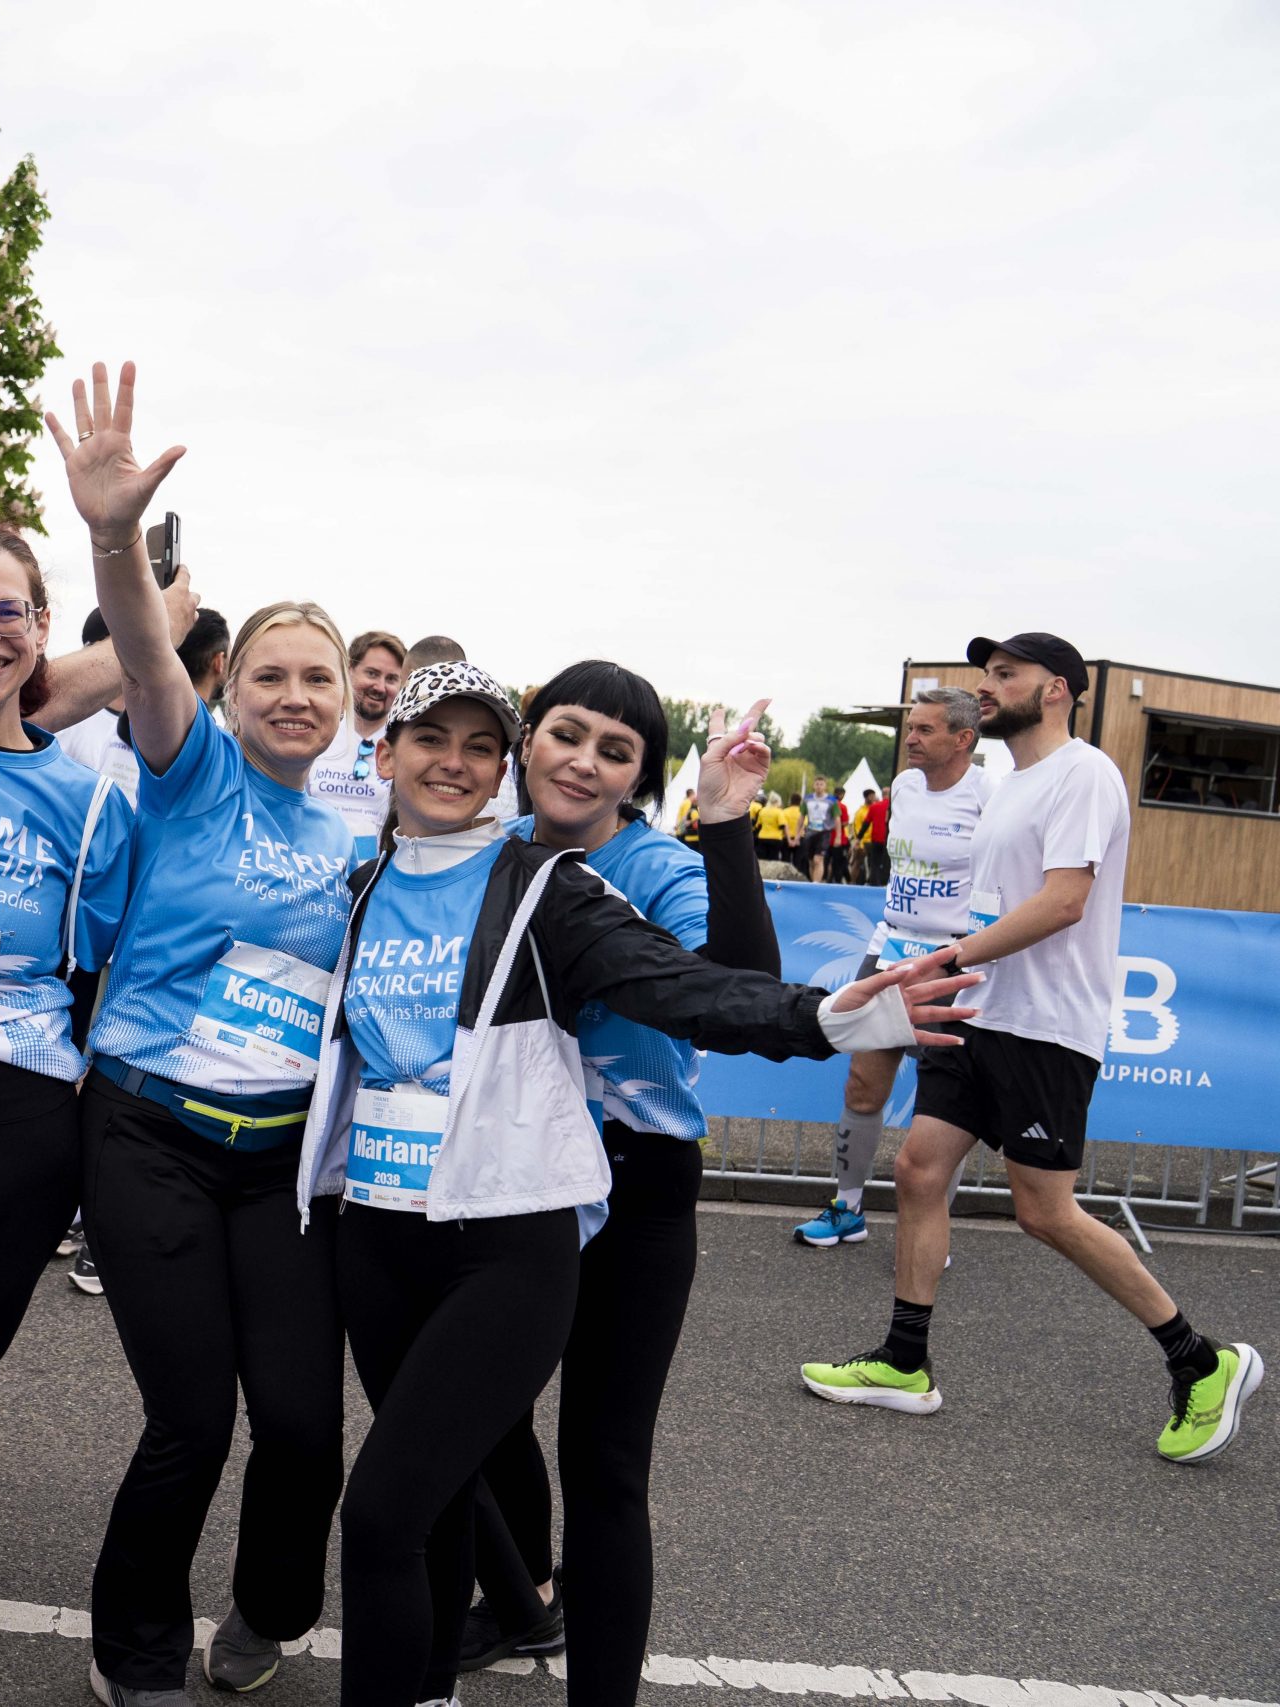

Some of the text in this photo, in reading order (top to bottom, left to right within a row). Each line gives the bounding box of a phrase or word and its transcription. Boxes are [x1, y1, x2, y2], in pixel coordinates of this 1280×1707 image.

[319, 781, 376, 797] Controls
[235, 872, 277, 900] Folge
[305, 901, 324, 916] ins
[222, 974, 321, 1036] Karolina
[390, 1004, 411, 1020] ins
[256, 1023, 285, 1042] 2057
[354, 1129, 442, 1167] Mariana
[373, 1171, 401, 1187] 2038
